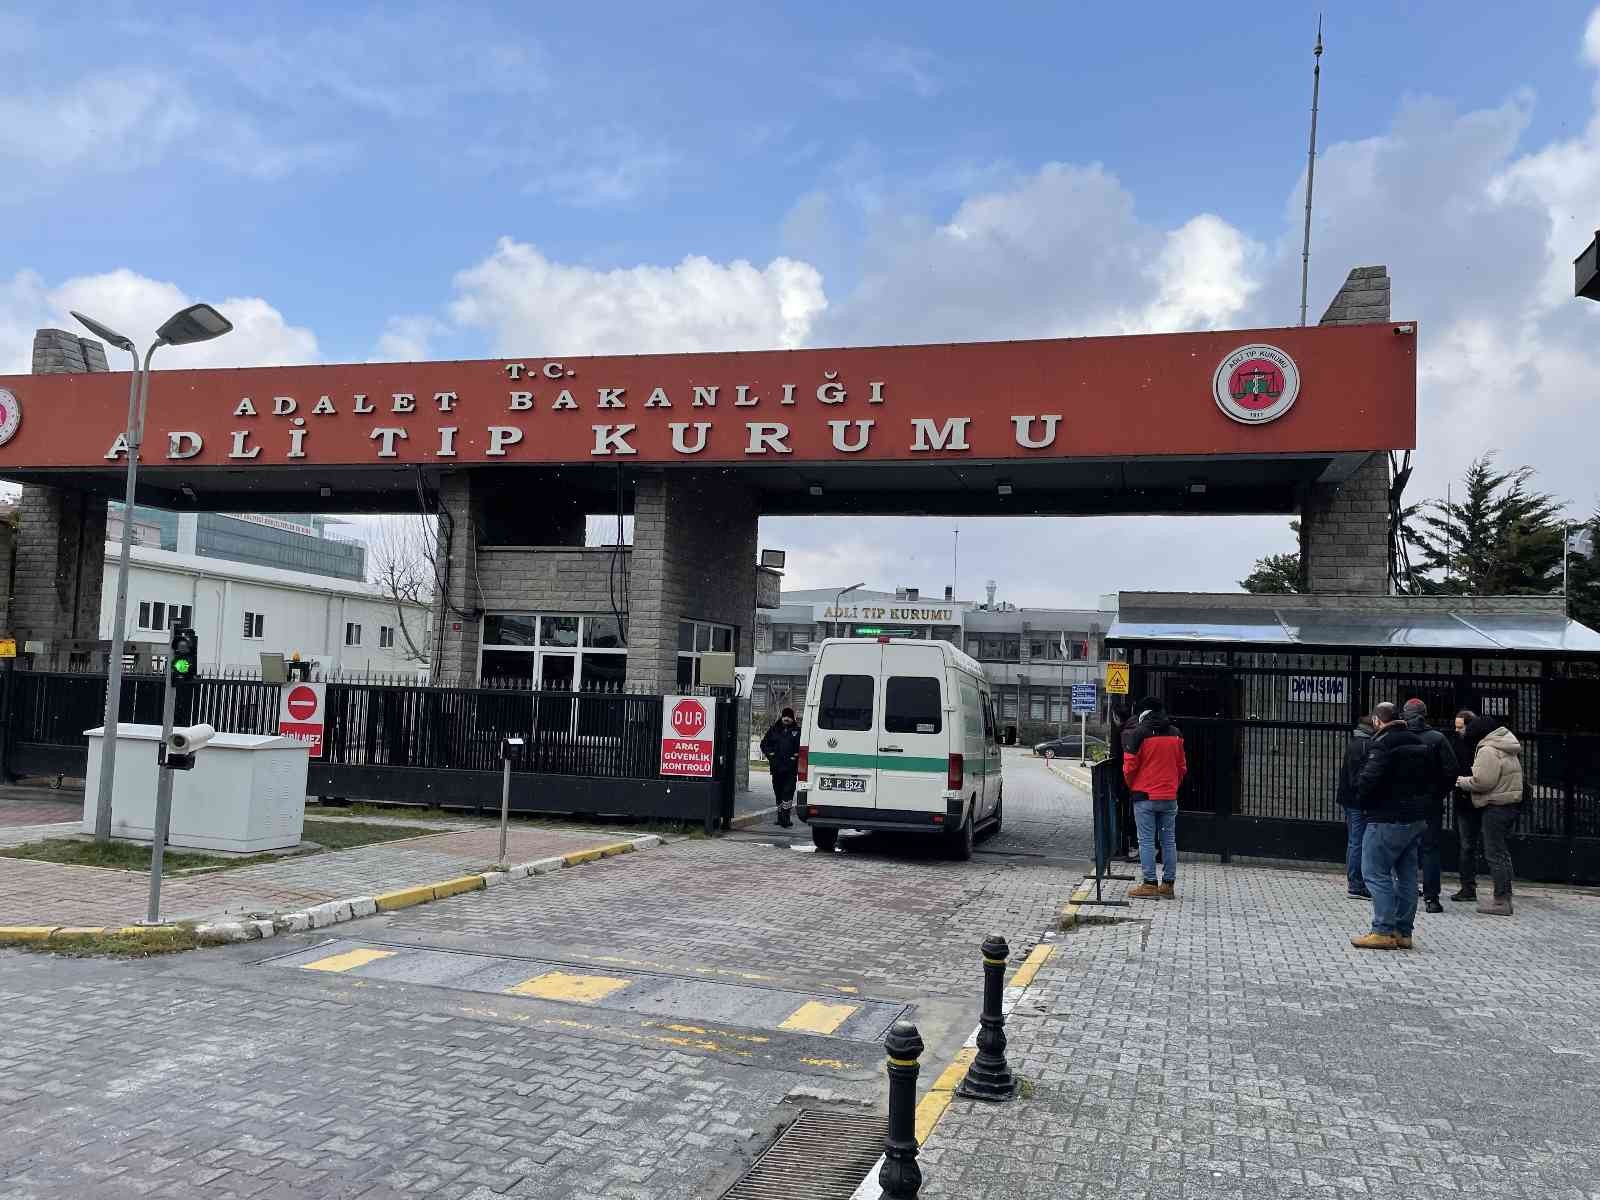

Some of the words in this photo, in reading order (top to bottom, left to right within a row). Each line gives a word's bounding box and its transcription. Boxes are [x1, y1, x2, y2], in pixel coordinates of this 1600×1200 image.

[505, 362, 576, 379] T.C.
[233, 391, 459, 416] ADALET
[508, 372, 885, 410] BAKANLIĞI
[103, 417, 307, 459] ADLİ
[369, 426, 523, 457] TIP
[590, 414, 1062, 455] KURUMU
[824, 605, 857, 618] ADLİ
[890, 608, 953, 621] KURUMU
[674, 711, 702, 726] DUR
[675, 742, 700, 753] ARAÇ
[664, 752, 710, 761] GÜVENLİK
[662, 762, 711, 772] KONTROLÜ
[823, 778, 832, 788] 34
[836, 779, 842, 789] P
